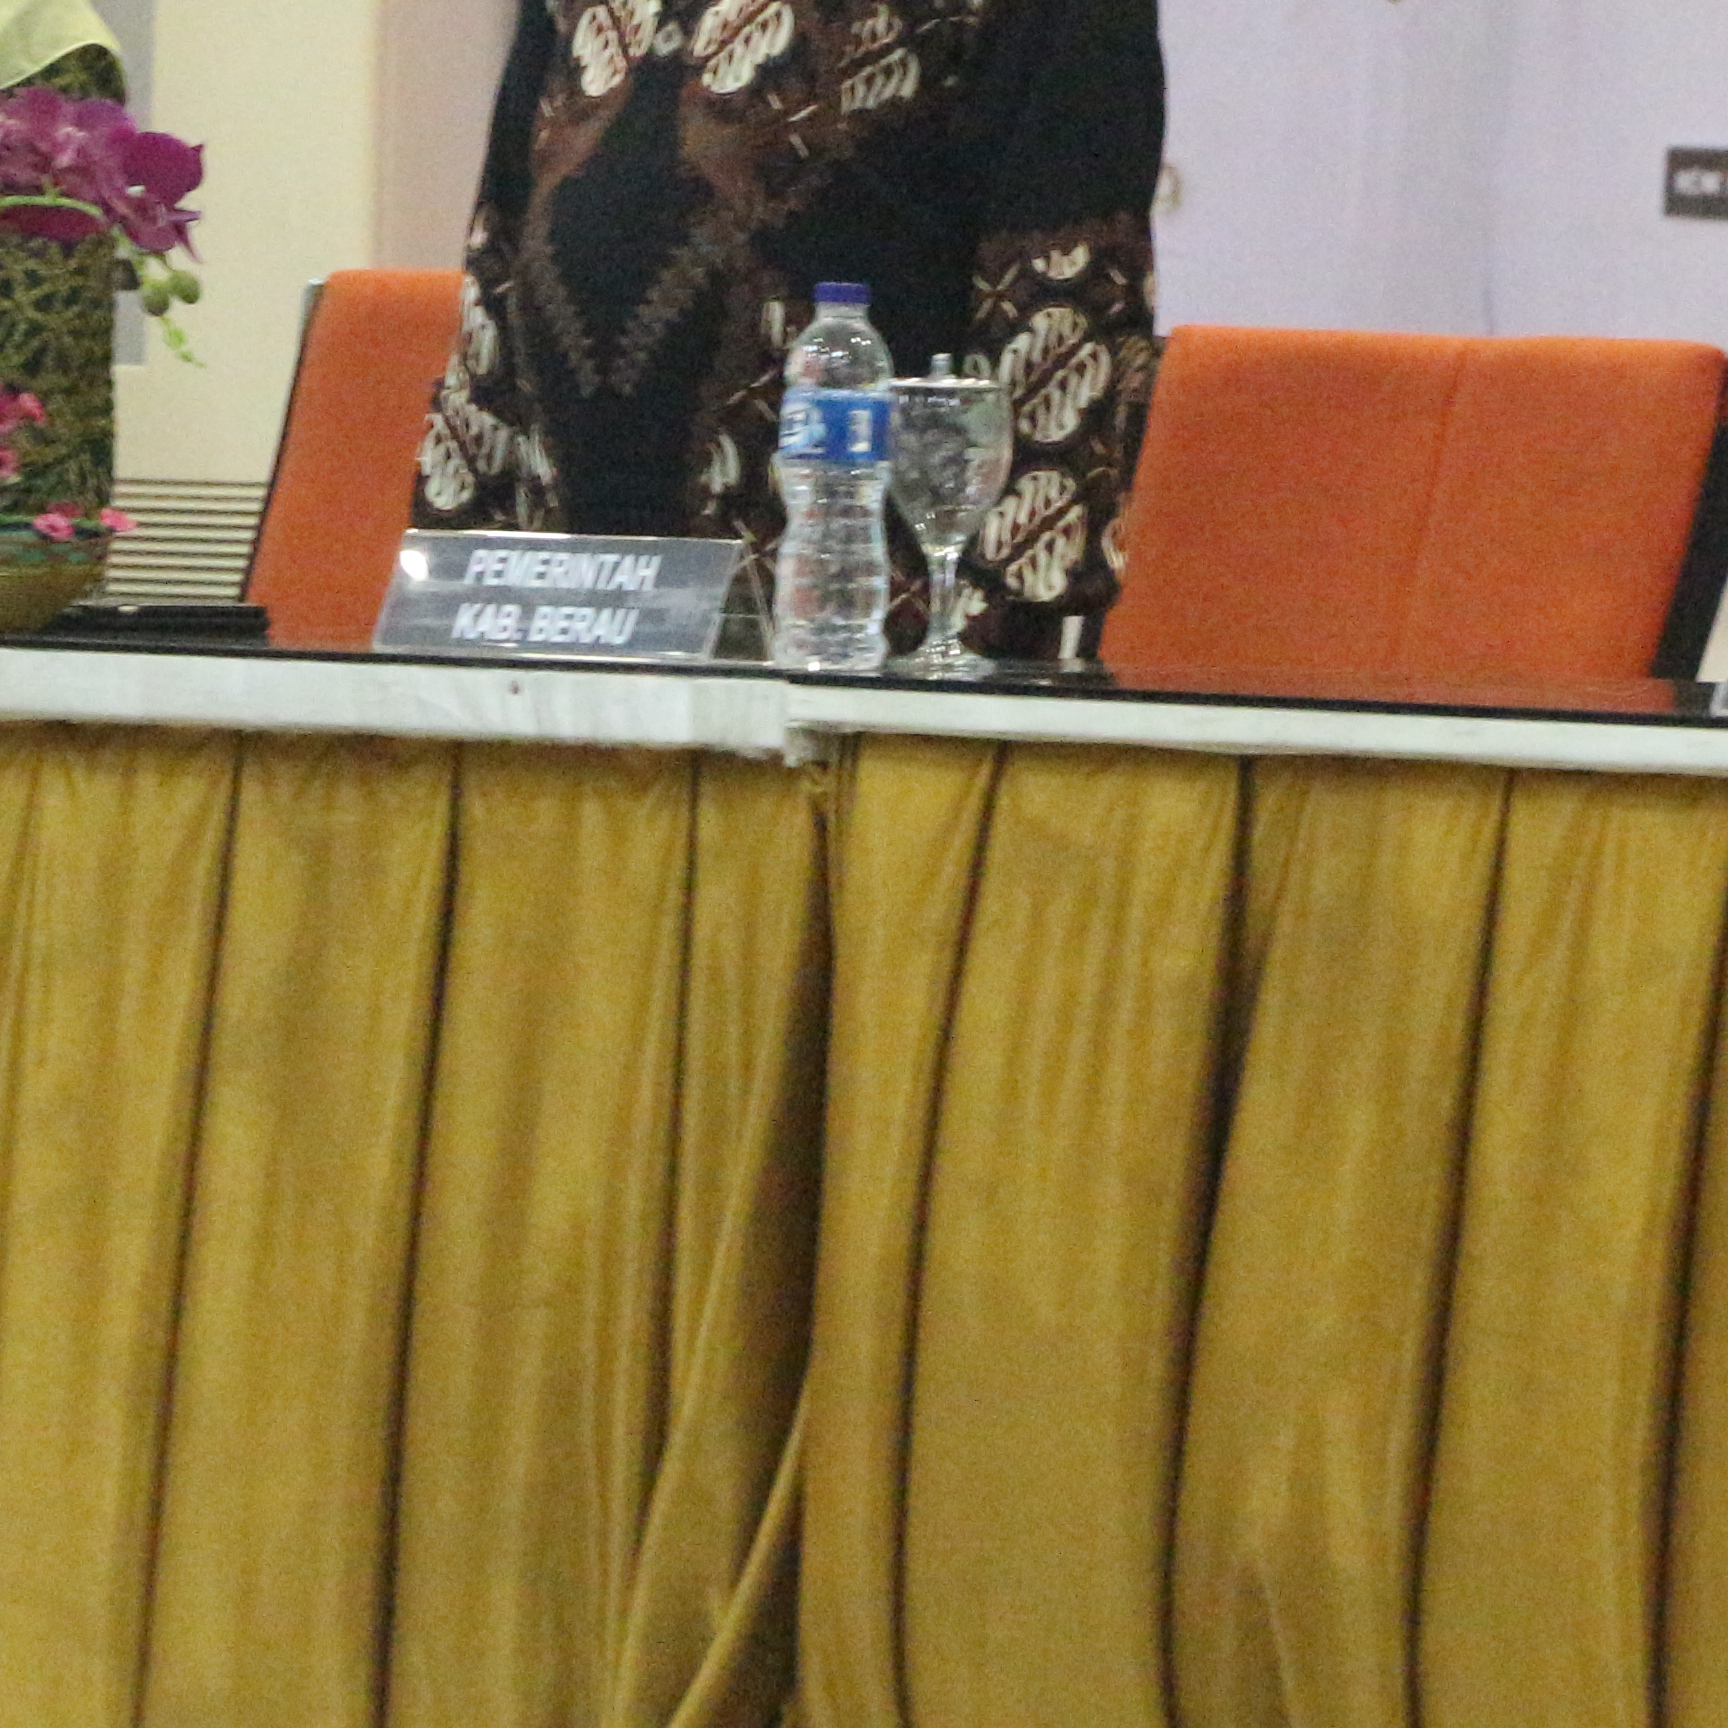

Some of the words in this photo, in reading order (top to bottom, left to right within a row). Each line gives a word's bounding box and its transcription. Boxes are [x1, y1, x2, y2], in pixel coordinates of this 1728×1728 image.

[463, 548, 663, 592] PEMERINTAH
[450, 602, 523, 641] KAB.
[526, 604, 640, 645] BERAU
